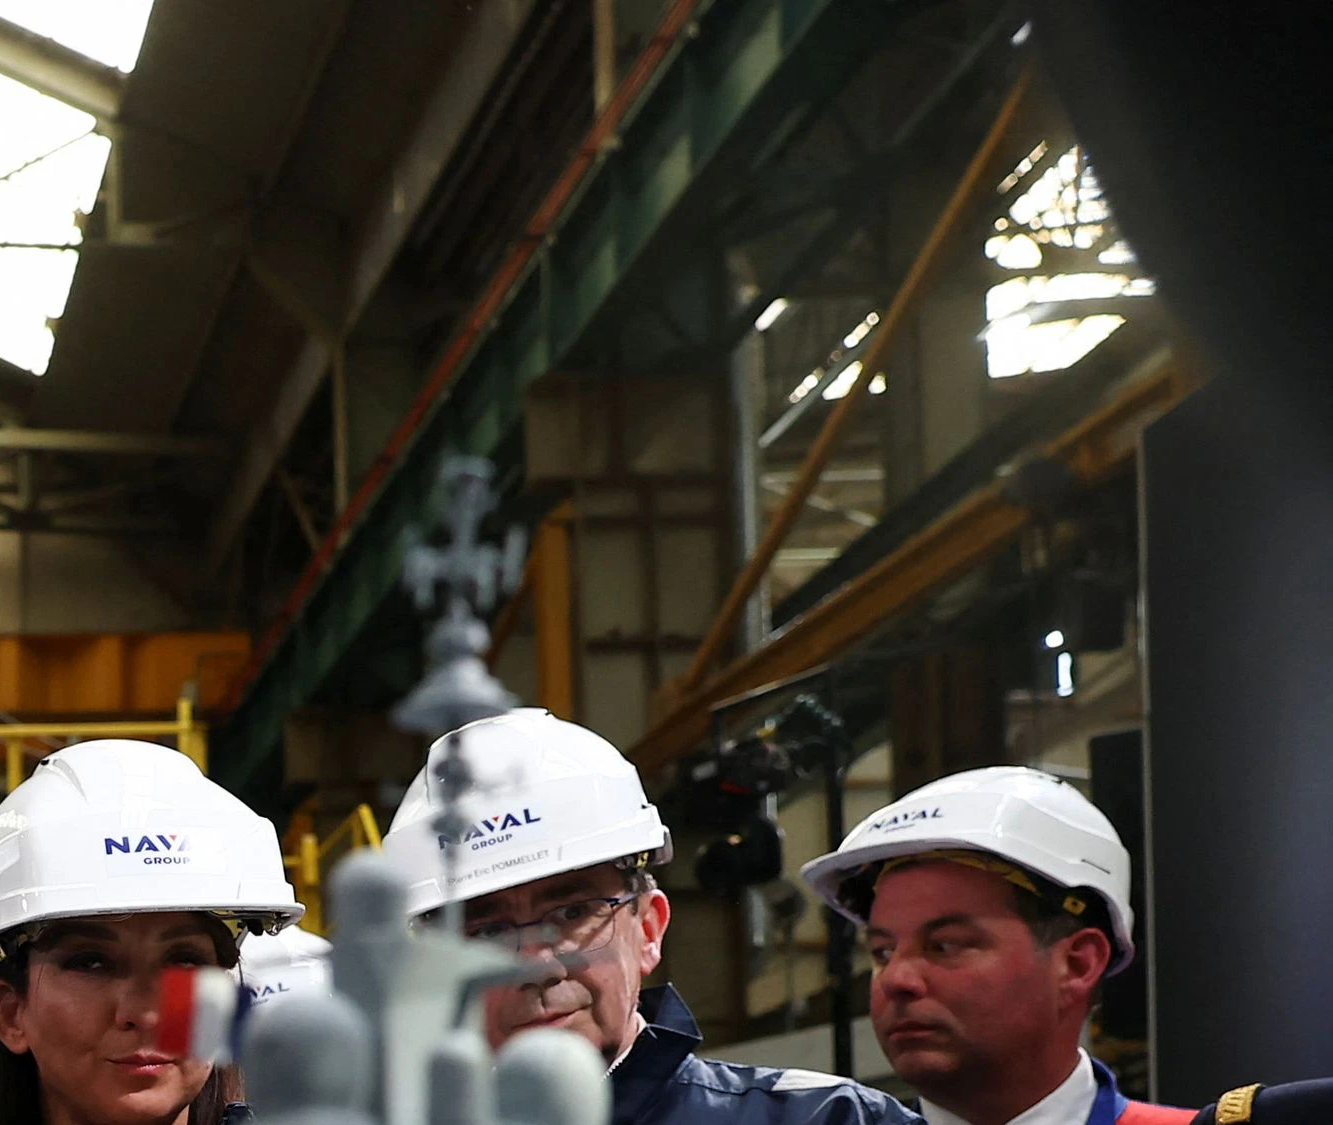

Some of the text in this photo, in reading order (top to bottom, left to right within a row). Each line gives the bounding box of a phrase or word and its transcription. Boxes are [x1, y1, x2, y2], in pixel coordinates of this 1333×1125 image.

[437, 808, 541, 850] NAVAL
[471, 833, 513, 851] GROUP
[143, 856, 190, 865] GROUP
